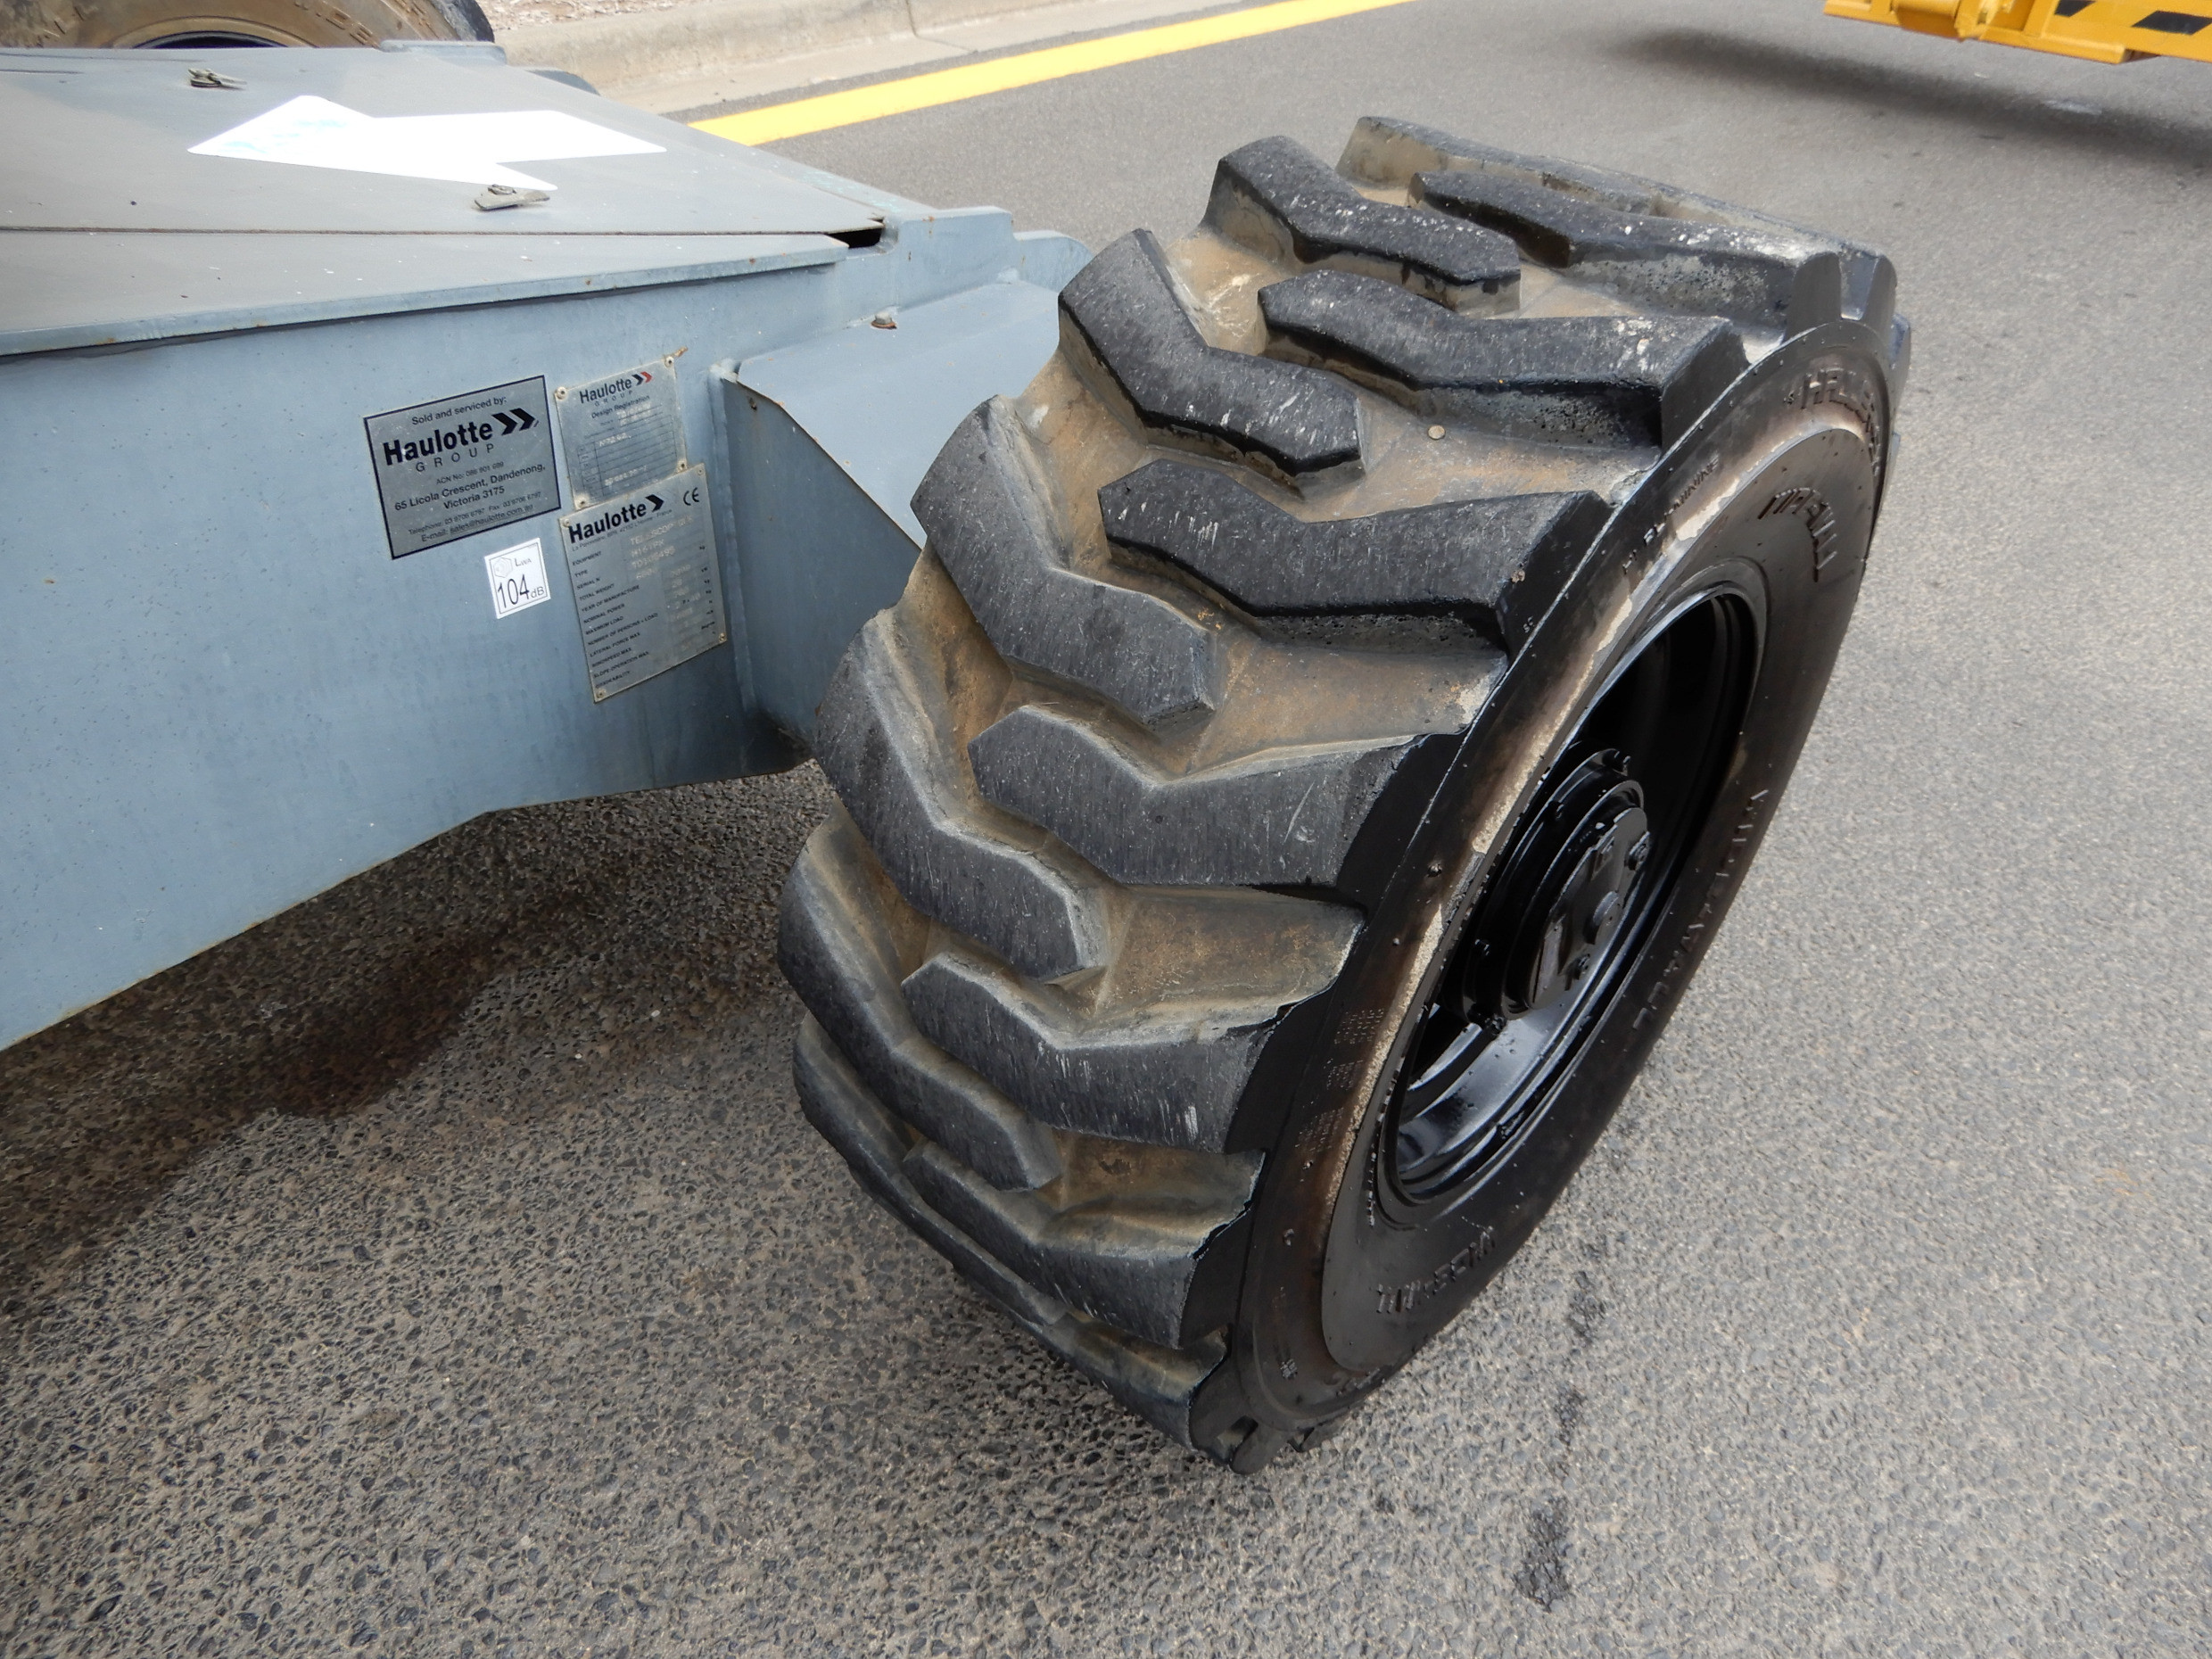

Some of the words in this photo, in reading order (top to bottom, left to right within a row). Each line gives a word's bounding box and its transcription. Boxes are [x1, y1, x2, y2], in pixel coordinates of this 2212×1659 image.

[579, 378, 631, 403] Haulotte
[594, 390, 632, 407] GROUP
[411, 412, 433, 425] Sold
[434, 408, 452, 419] and
[453, 398, 491, 415] serviced
[492, 396, 507, 405] by:
[590, 408, 613, 418] Design
[614, 395, 649, 411] Registration
[383, 421, 492, 466] Haulotte
[415, 442, 493, 472] GROUP
[394, 499, 407, 510] 65
[409, 492, 439, 507] Licola
[441, 478, 488, 497] Crescent,
[490, 463, 545, 483] Dandenong,
[435, 475, 451, 485] ACN
[442, 493, 480, 508] Victoria
[482, 485, 505, 499] 3175
[420, 528, 448, 541] E-mail:
[568, 503, 646, 543] Haulotte
[572, 550, 601, 565] EQUIPMENT
[574, 569, 588, 577] TYPE
[576, 579, 595, 590] SERIAL
[497, 574, 529, 607] 104
[579, 591, 595, 600] TOTAL
[595, 582, 614, 594] WEIGHT
[581, 603, 595, 611] YEAR
[603, 584, 639, 602] MANUFACTURE
[582, 611, 606, 623] NOMINAL
[607, 603, 624, 613] POWER
[585, 621, 609, 634] MAXIMUM
[609, 615, 623, 624] LOAD
[587, 633, 608, 645] NUMBER
[616, 620, 640, 632] PERSONS
[644, 612, 657, 621] LOAD
[590, 645, 611, 657] LATERAL
[612, 637, 629, 647] FORCE
[593, 668, 609, 679] SLOPE
[638, 650, 648, 658] MAX
